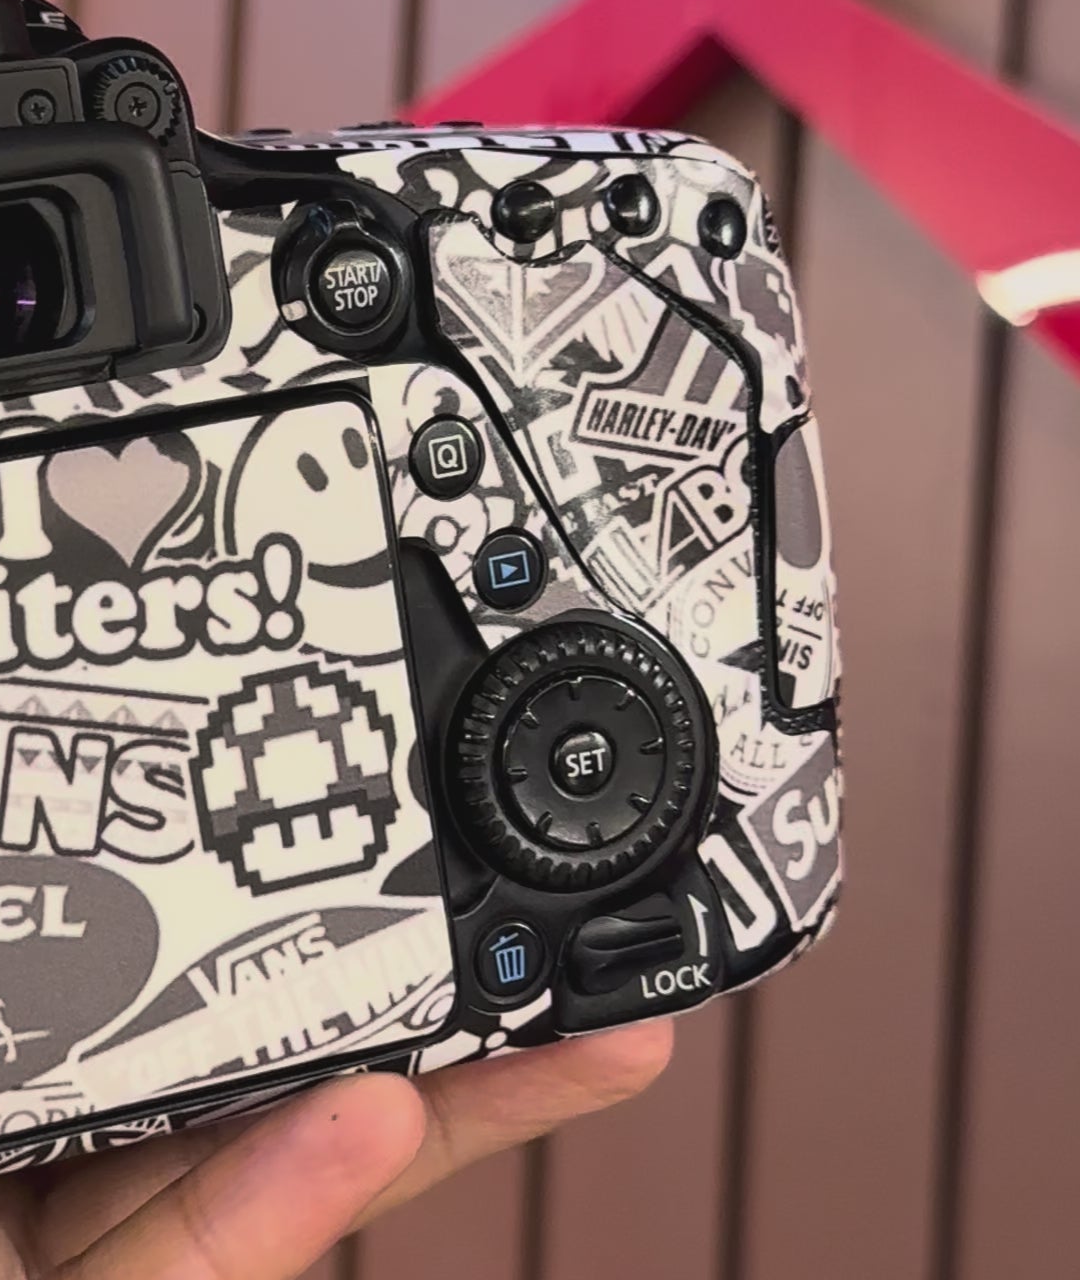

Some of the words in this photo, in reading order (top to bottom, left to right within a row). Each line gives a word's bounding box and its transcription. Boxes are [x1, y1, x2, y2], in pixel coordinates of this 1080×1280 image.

[324, 262, 382, 290] START/
[334, 286, 379, 312] STOP
[565, 748, 606, 777] SET
[730, 733, 787, 770] ALL
[185, 911, 337, 1008] VANS
[640, 963, 711, 999] LOCK
